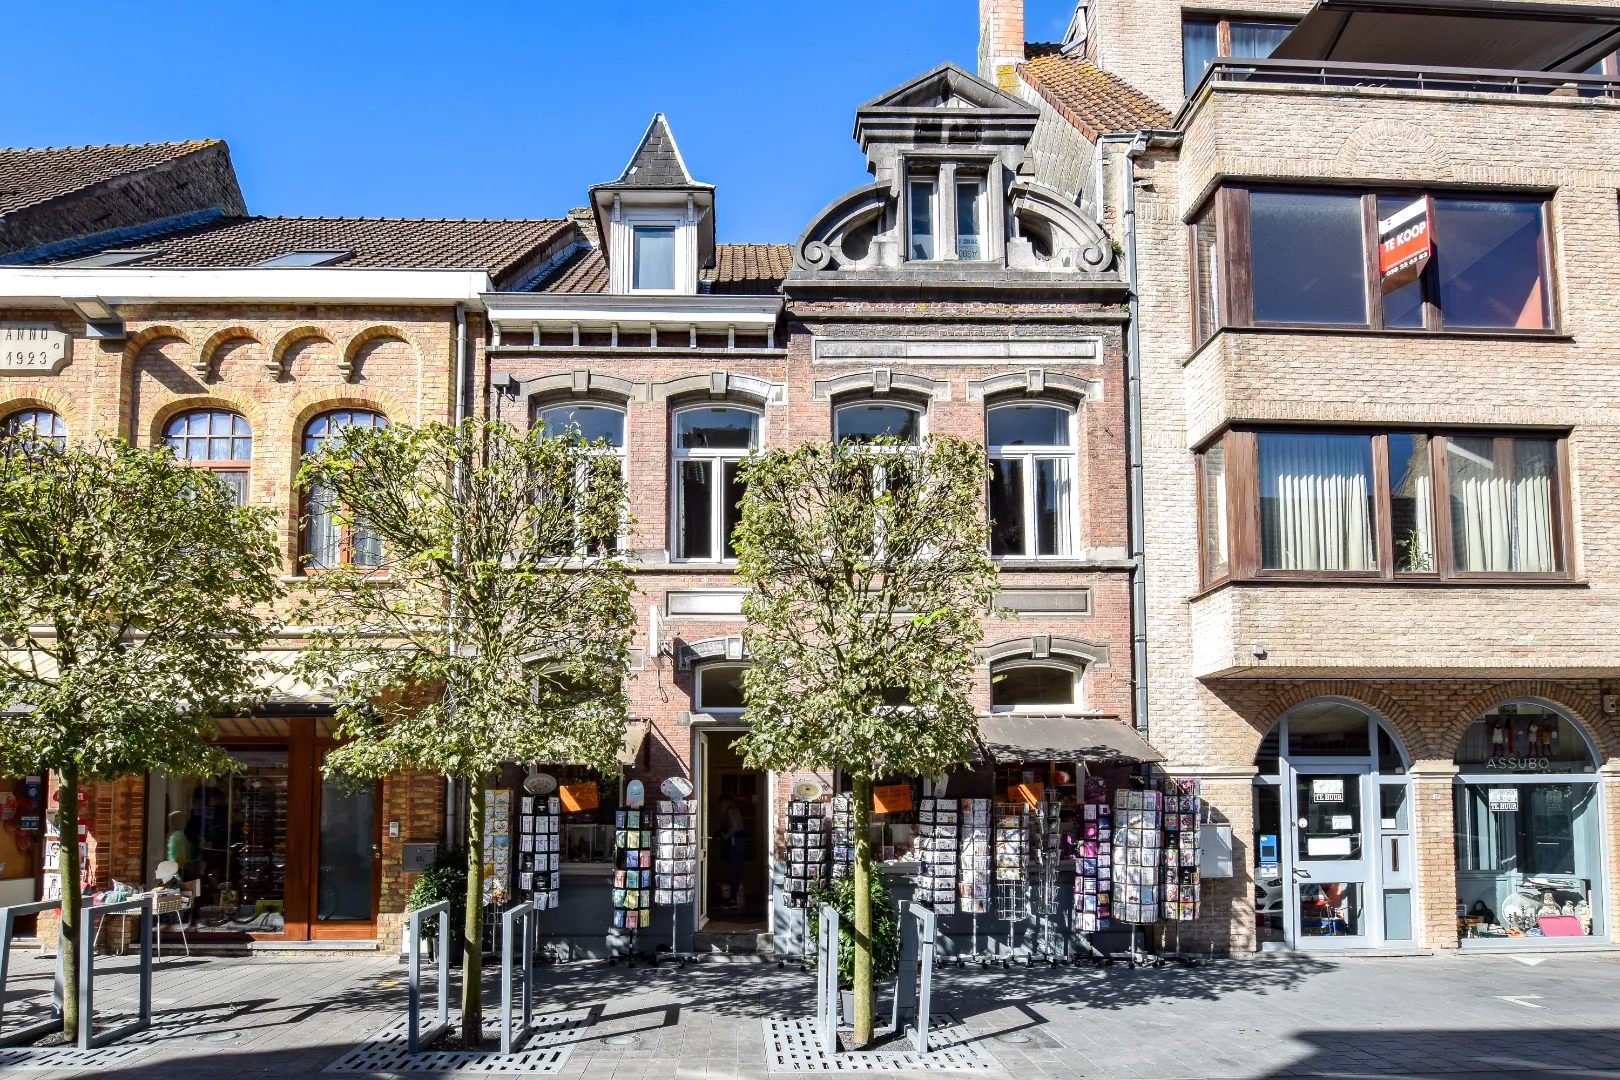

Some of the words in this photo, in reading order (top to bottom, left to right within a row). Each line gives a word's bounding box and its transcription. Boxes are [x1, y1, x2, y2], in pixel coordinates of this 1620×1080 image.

[1384, 237, 1396, 252] TE
[1396, 220, 1427, 247] KOOP
[5, 327, 48, 341] ANNO
[5, 351, 47, 365] 1923
[1486, 757, 1550, 769] ASSUBO
[1315, 793, 1324, 801] TE
[1324, 793, 1342, 801] HUUR
[1490, 802, 1500, 810] TE
[1500, 802, 1517, 810] HUUR
